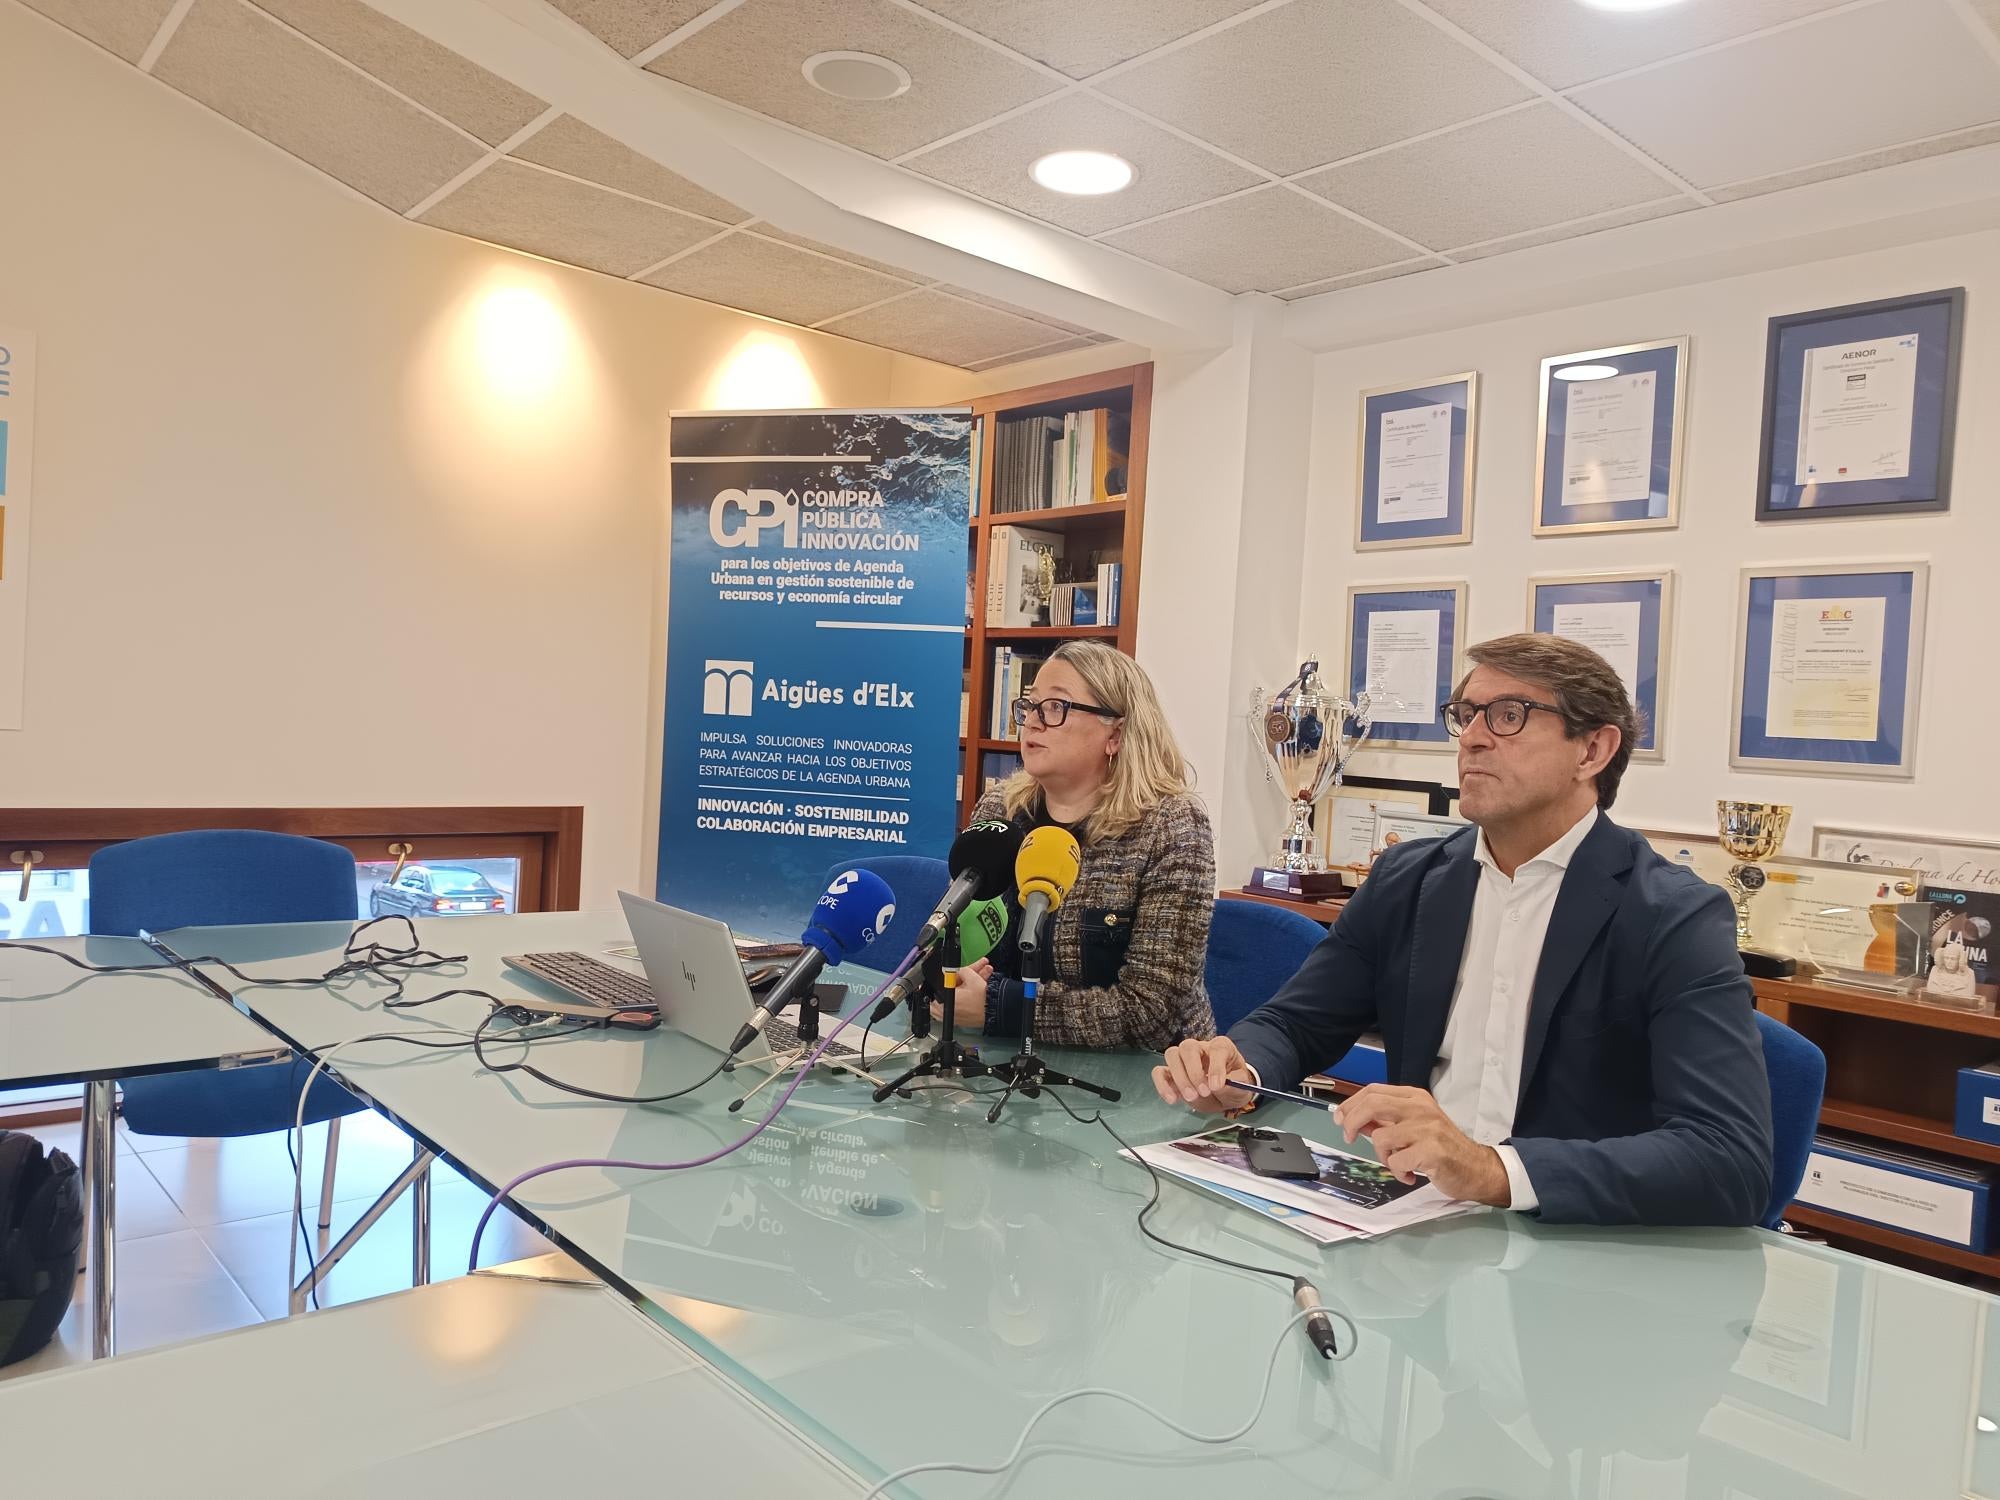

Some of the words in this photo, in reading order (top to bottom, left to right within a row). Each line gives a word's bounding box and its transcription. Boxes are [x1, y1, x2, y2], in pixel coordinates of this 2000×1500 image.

[1841, 349, 1876, 360] AENOR
[803, 490, 885, 508] COMPRA
[802, 509, 882, 529] PÚBLICA
[802, 531, 919, 551] INNOVACIÓN
[721, 560, 747, 571] para
[751, 557, 769, 569] los
[773, 558, 832, 573] objetivos
[835, 559, 850, 571] de
[854, 560, 903, 575] Agenda
[711, 573, 754, 584] Urbana
[757, 576, 773, 585] en
[776, 575, 824, 588] gestión
[827, 576, 894, 588] sostenible
[897, 577, 914, 589] de
[720, 591, 773, 601] recursos
[777, 592, 785, 604] y
[788, 591, 850, 603] economía
[853, 592, 903, 605] circular
[762, 679, 843, 708] Aigües
[853, 682, 914, 707] d'Elx
[701, 732, 746, 744] IMPULSA
[757, 735, 824, 748] SOLUCIONES
[834, 740, 912, 754] INNOVADORAS
[700, 749, 726, 759] PARA
[732, 751, 782, 762] AVANZAR
[788, 754, 820, 765] HACIA
[826, 756, 846, 767] LOS
[851, 758, 911, 771] OBJETIVOS
[700, 765, 778, 779] ESTRATÉGICOS
[782, 770, 796, 780] DE
[800, 771, 813, 781] LA
[817, 773, 861, 784] AGENDA
[866, 776, 910, 788] URBANA
[698, 798, 783, 815] INNOVACIÓN
[795, 805, 909, 825] SOSTENIBILIDAD
[697, 816, 804, 835] COLABORACIÓN
[808, 824, 906, 843] EMPRESARIAL
[1947, 930, 1963, 944] LA
